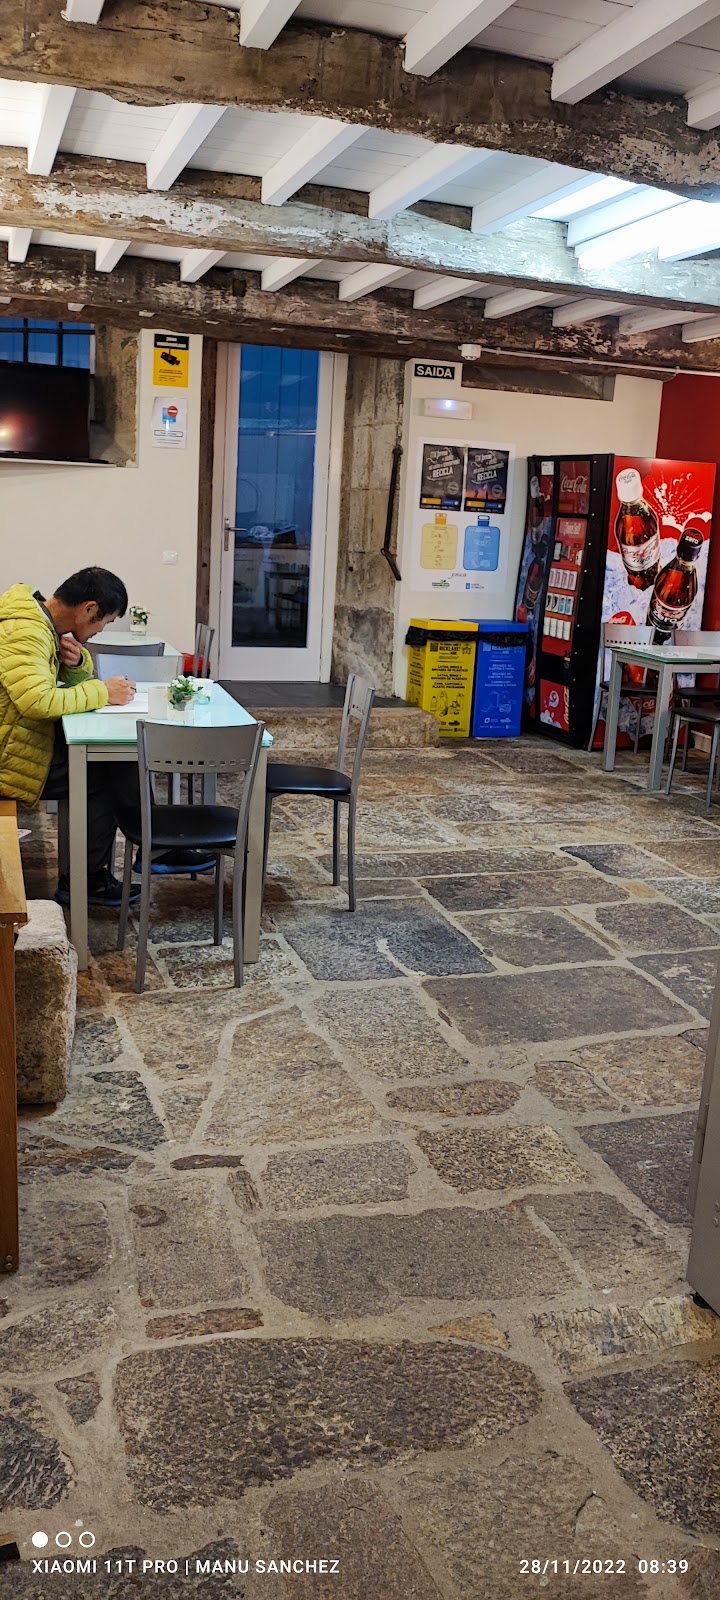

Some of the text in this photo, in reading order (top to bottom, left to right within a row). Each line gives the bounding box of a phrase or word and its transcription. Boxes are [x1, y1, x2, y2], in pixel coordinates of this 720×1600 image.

[416, 365, 453, 378] SAIDA
[432, 466, 454, 478] RECICLA
[476, 470, 498, 481] RECICLA
[684, 534, 699, 545] zero
